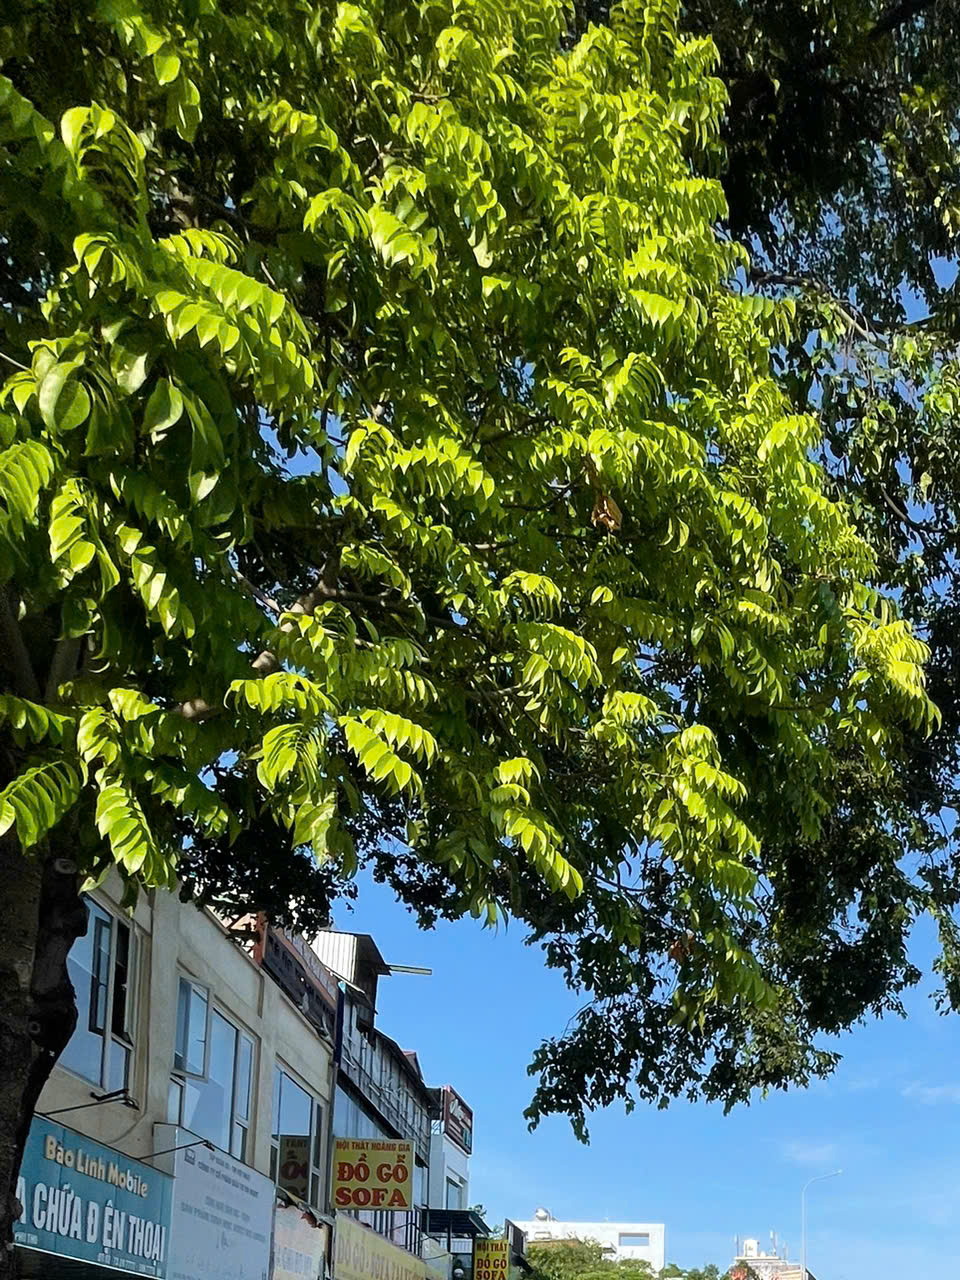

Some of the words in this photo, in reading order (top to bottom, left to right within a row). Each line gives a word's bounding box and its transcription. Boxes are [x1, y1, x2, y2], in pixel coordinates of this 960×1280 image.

[76, 1149, 105, 1181] Linh
[108, 1160, 148, 1197] Mobile
[376, 1154, 408, 1184] GỖ
[336, 1187, 408, 1207] SOFA
[128, 1214, 166, 1266] THOẠI
[476, 1270, 506, 1280] SOFA
